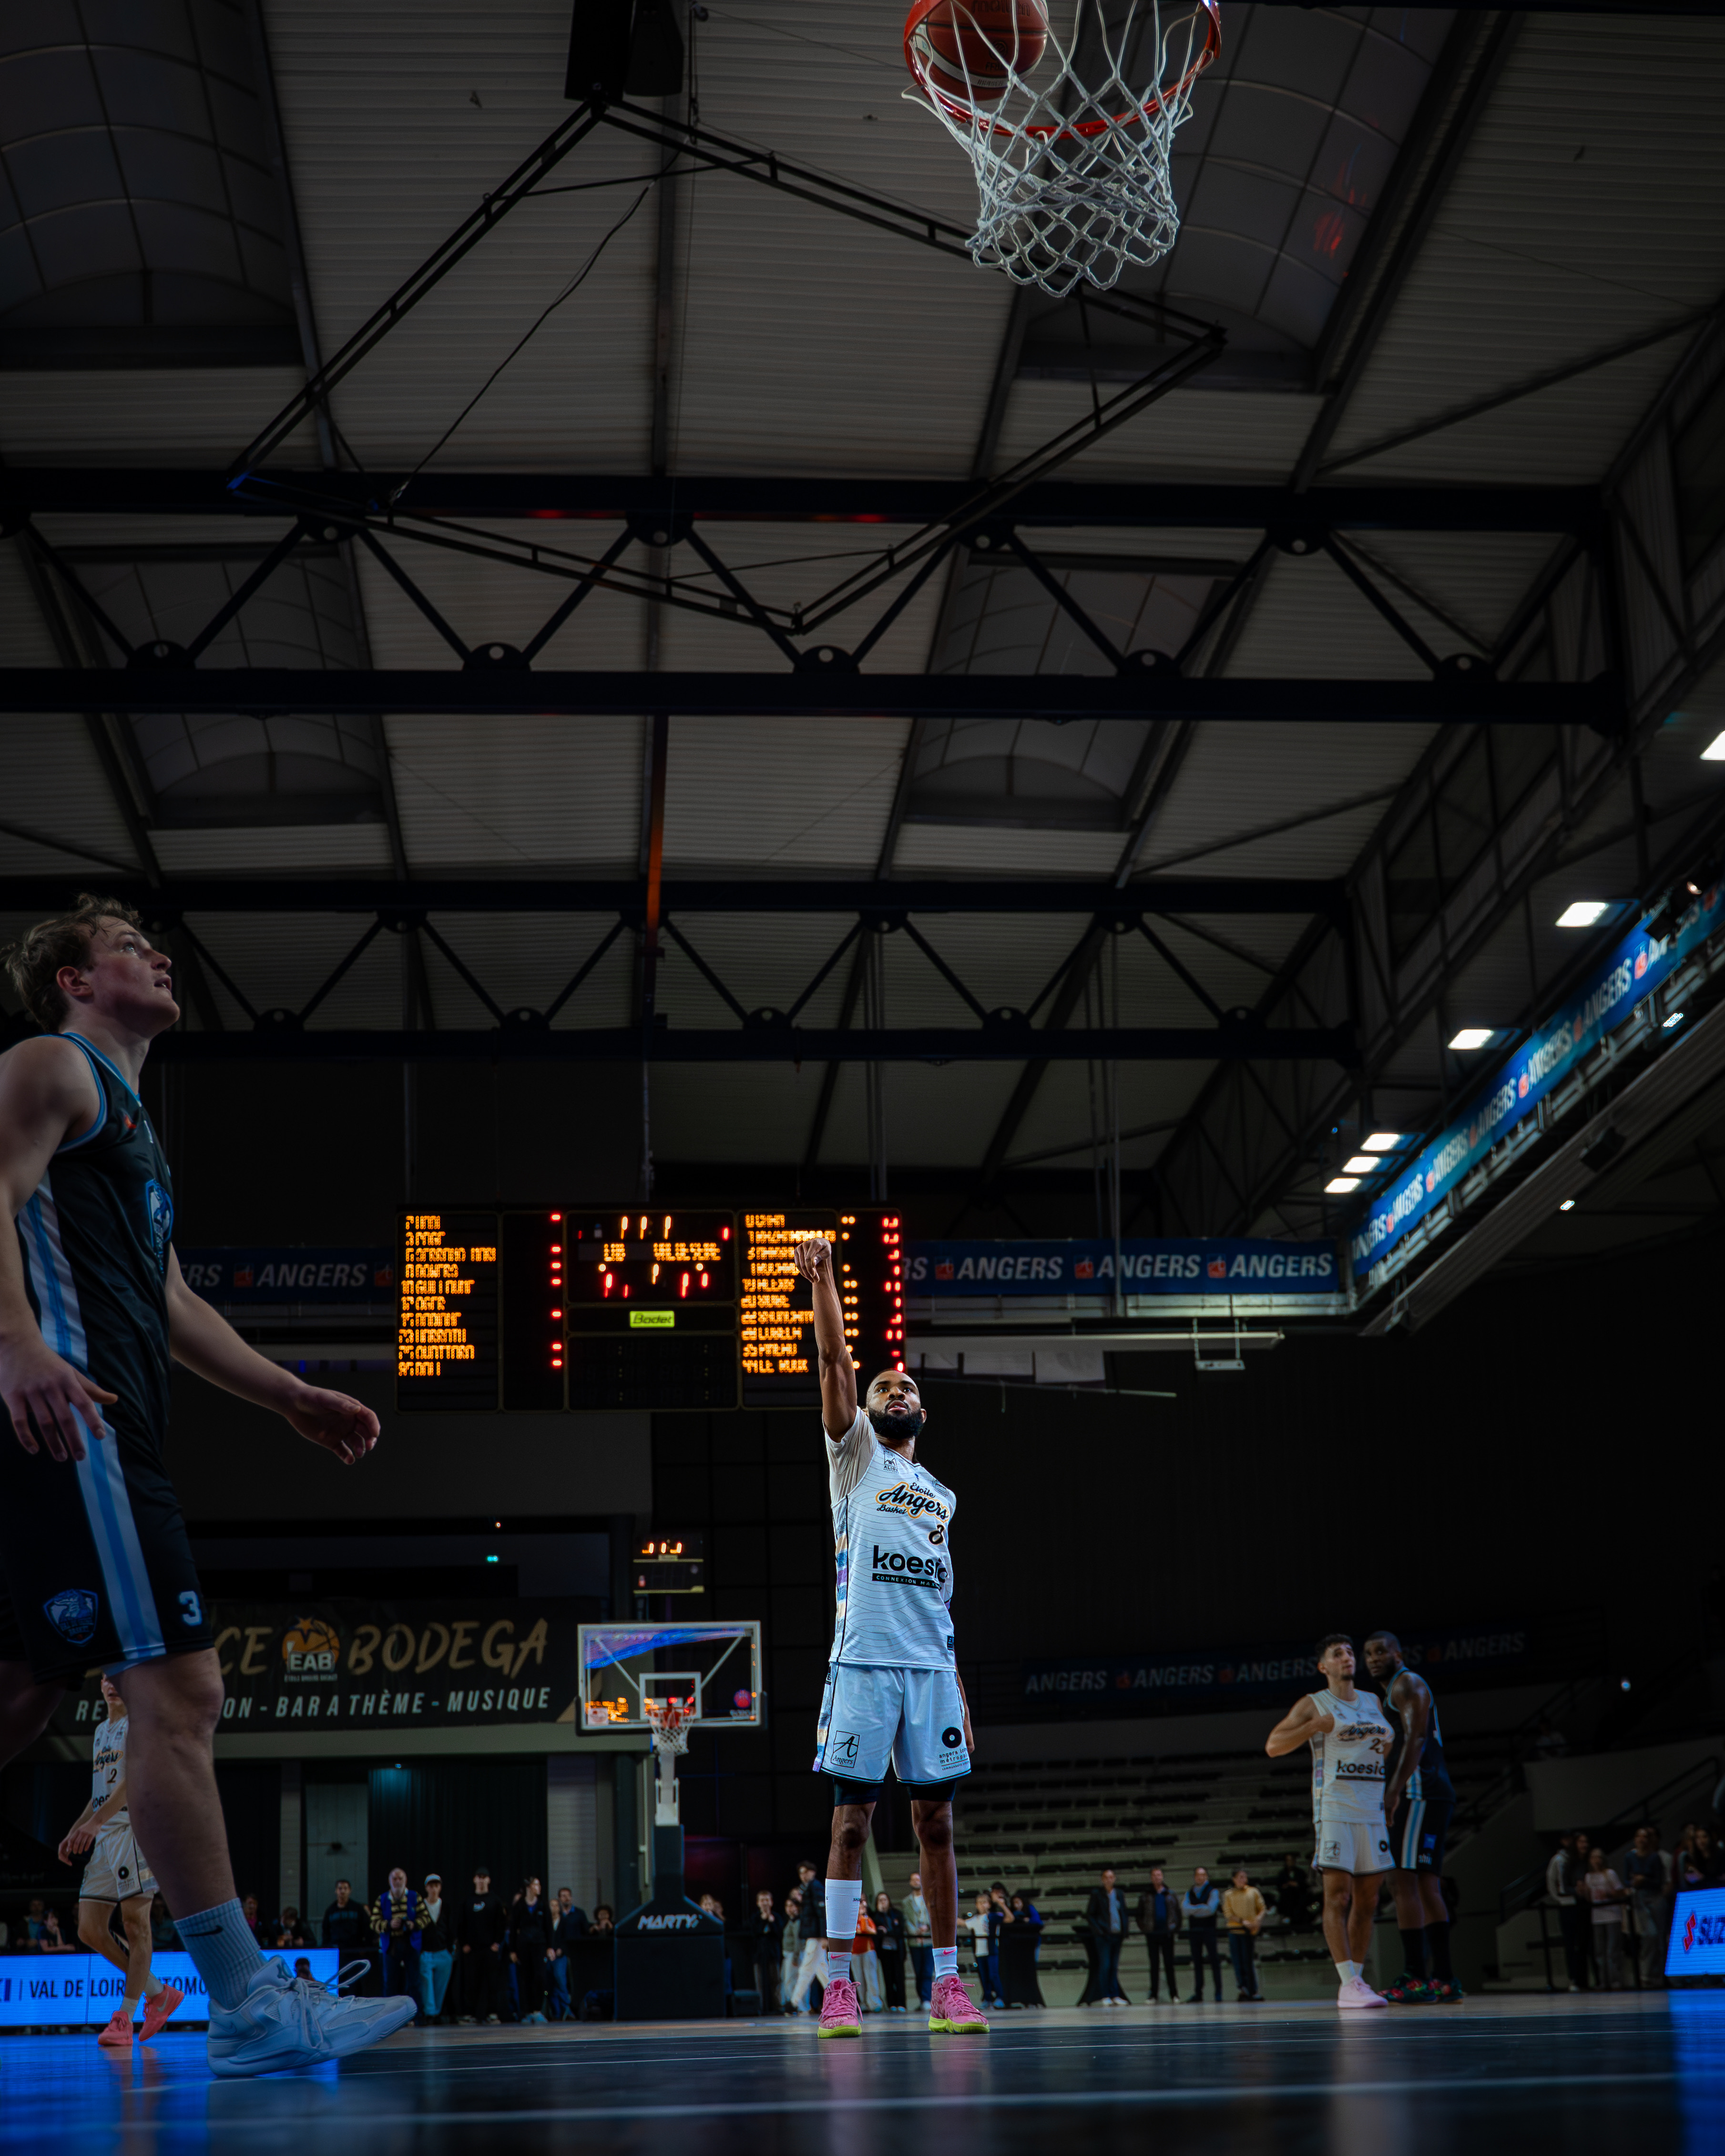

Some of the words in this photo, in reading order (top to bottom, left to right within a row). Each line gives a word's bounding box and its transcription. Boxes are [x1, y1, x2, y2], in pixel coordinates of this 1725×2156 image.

[256, 1262, 369, 1288] ANGERS
[956, 1256, 1064, 1281] ANGERS
[1096, 1253, 1201, 1279] ANGERS
[1229, 1253, 1333, 1278] ANGERS
[879, 1485, 949, 1520] Angers
[910, 1482, 936, 1498] Etoile
[877, 1504, 908, 1514] Basket
[928, 1524, 944, 1545] 8
[876, 1575, 916, 1585] CONNEXION
[178, 1589, 203, 1627] 3
[290, 1653, 333, 1672] EAB
[347, 1617, 549, 1680] BODEGA
[1443, 1631, 1526, 1663] ANGERS
[1025, 1669, 1108, 1695] ANGERS
[1132, 1665, 1215, 1689] ANGERS
[276, 1694, 324, 1718] BAR
[327, 1694, 339, 1717] A
[348, 1689, 426, 1716] THÈME
[447, 1687, 551, 1712] MUSIQUE
[832, 1755, 853, 1765] Angers
[106, 1768, 117, 1783] 2
[30, 1980, 58, 1998] VAL
[65, 1980, 83, 1997] DE
